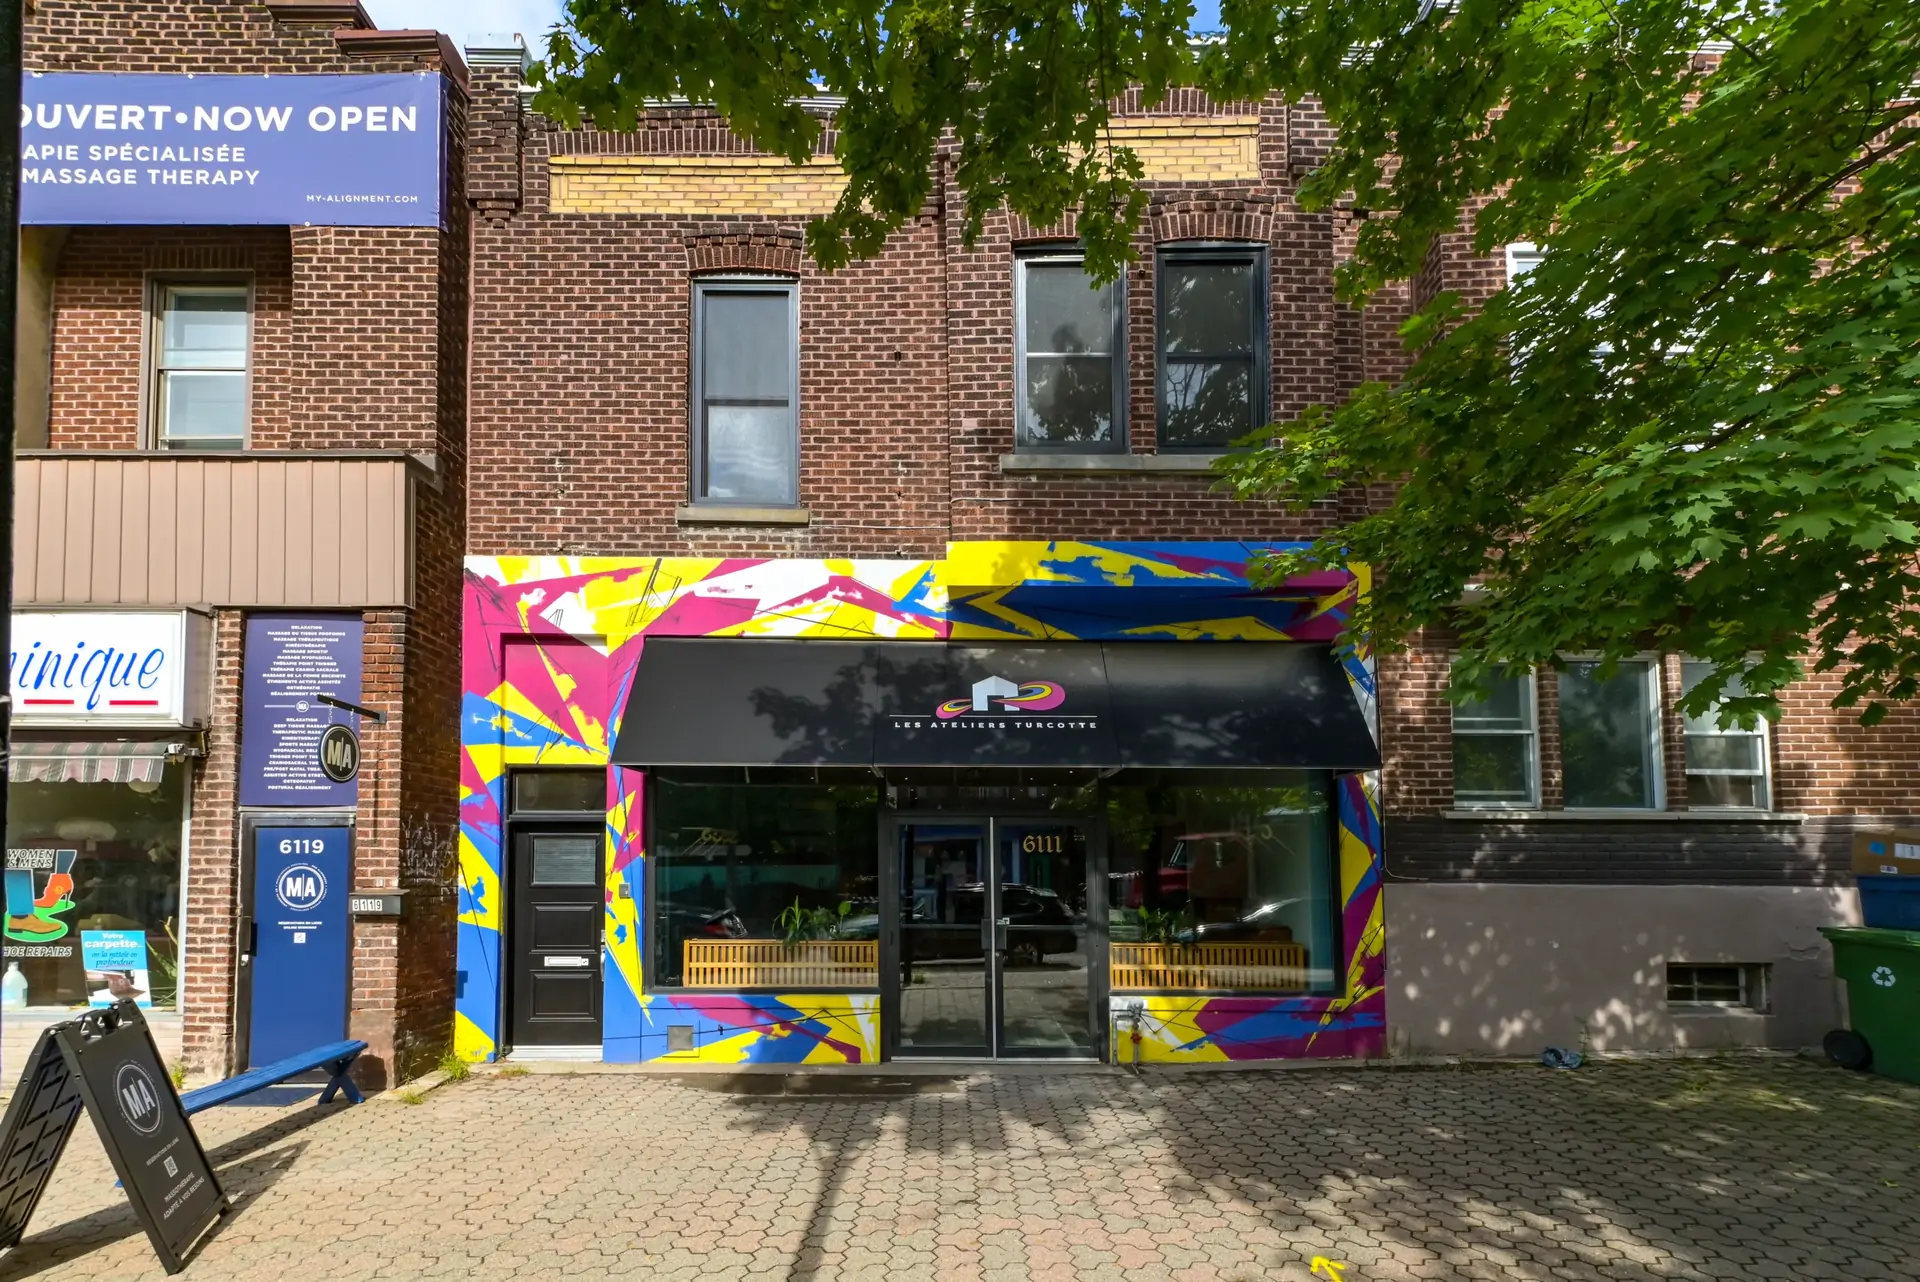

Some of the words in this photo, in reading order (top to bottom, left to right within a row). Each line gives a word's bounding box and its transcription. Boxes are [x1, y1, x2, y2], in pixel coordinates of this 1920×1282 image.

[193, 106, 293, 132] NOW
[308, 106, 417, 132] OPEN
[89, 142, 245, 162] SPÉCIALISÉE
[21, 168, 138, 185] MASSAGE
[147, 169, 260, 186] THERAPY
[306, 194, 418, 203] MY-ALIGNMENT.COM
[10, 641, 164, 710] inique
[279, 839, 324, 854] 6119
[1023, 835, 1062, 854] 6111
[7, 849, 54, 860] WOMEN
[8, 859, 18, 868] &
[18, 858, 53, 868] MENS
[354, 900, 382, 910] 6119
[26, 946, 72, 958] REPAIRS
[95, 958, 134, 968] profondeur
